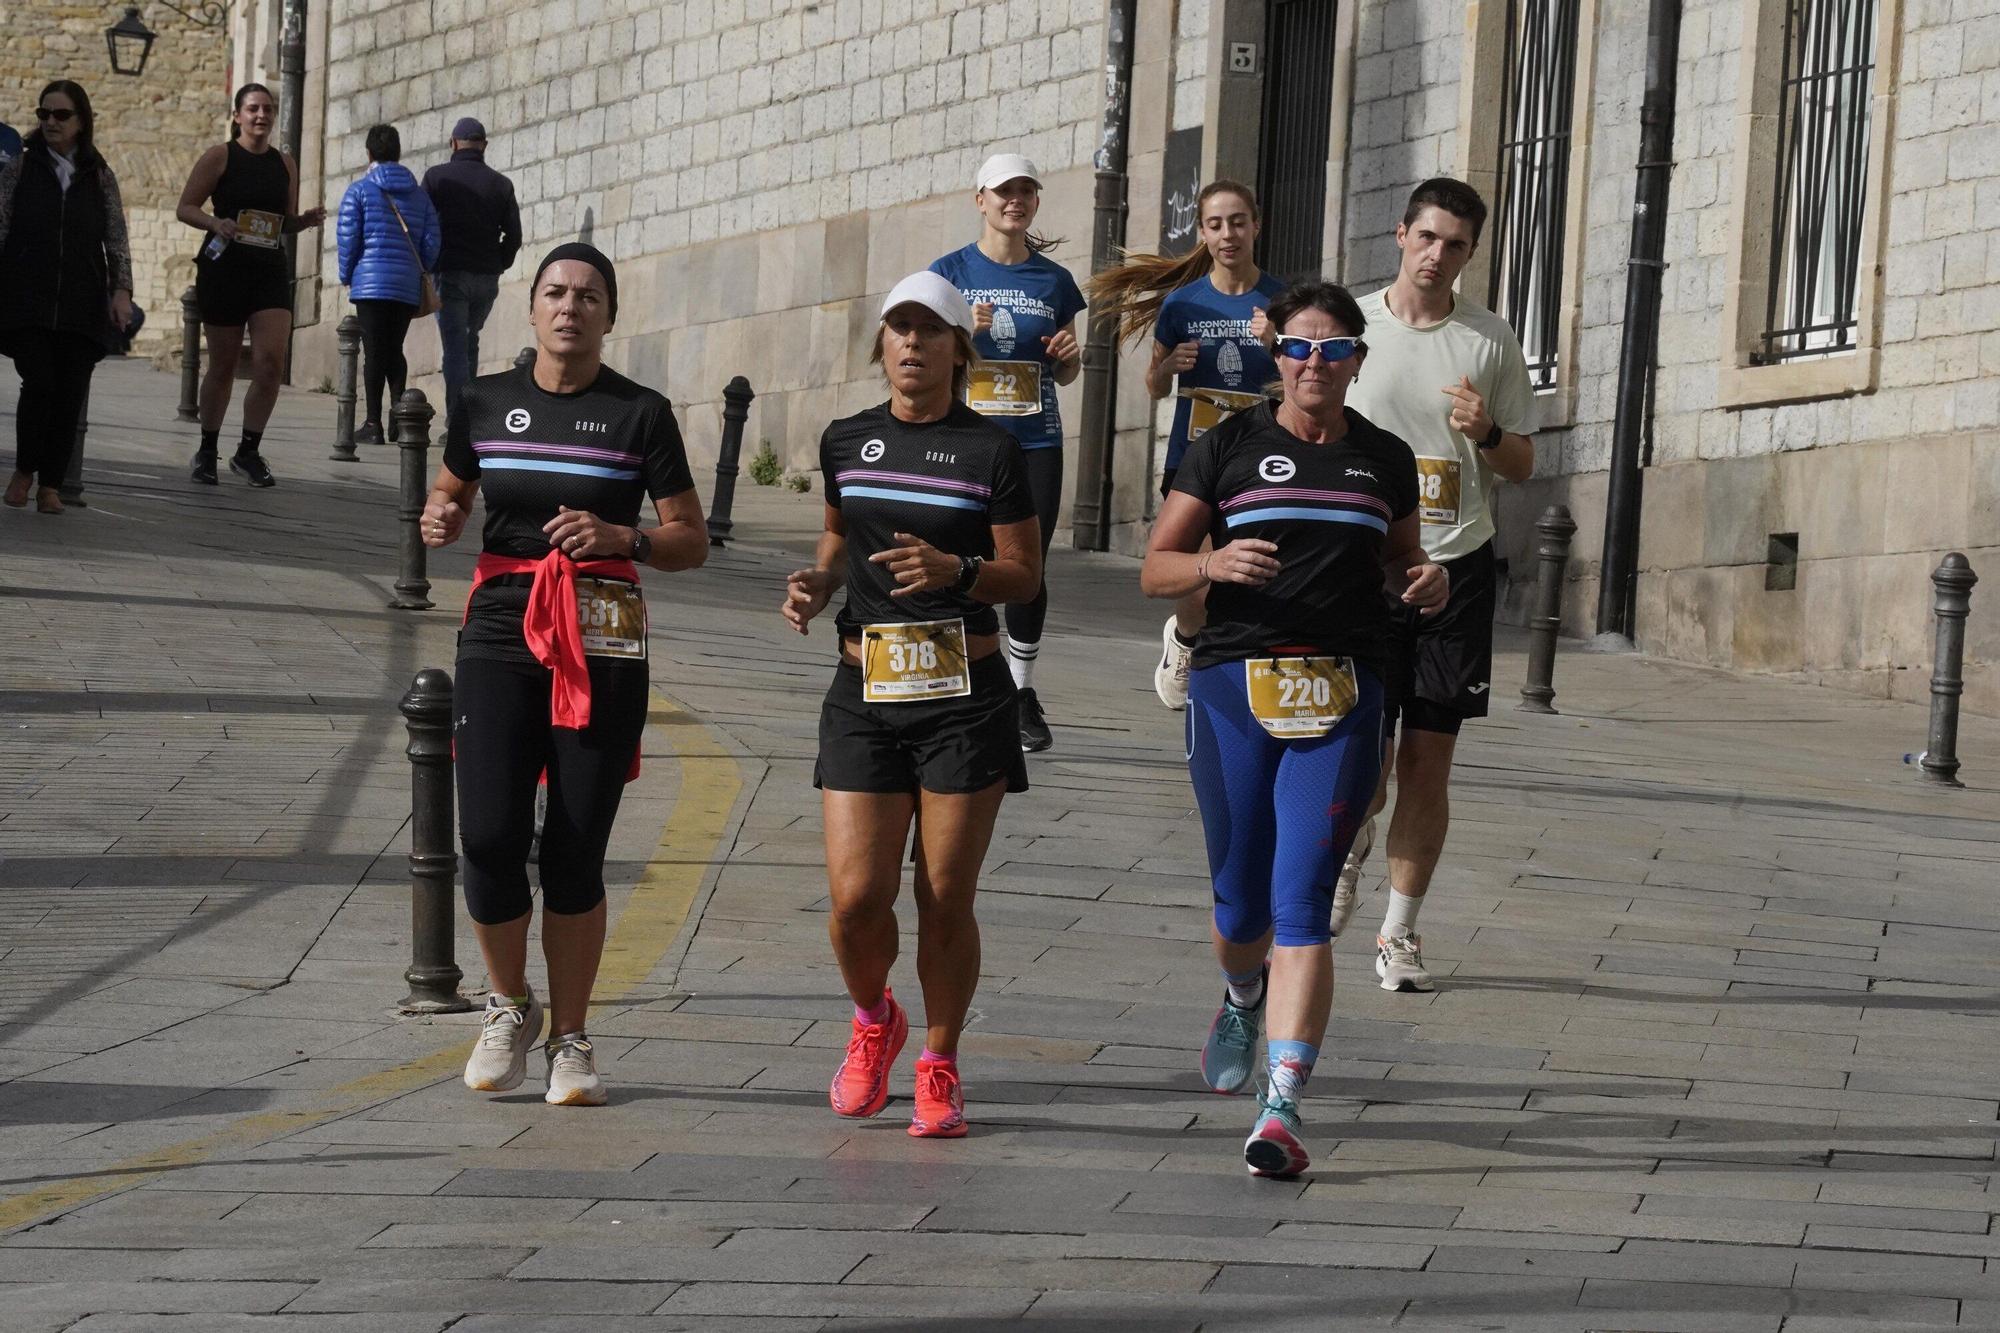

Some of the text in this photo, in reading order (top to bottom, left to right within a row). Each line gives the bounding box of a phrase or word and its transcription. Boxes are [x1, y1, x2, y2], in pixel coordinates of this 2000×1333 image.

[970, 288, 1026, 298] CONQUISTA
[1012, 306, 1055, 321] KONKISTA
[1187, 319, 1253, 329] LA CONQUISTA
[993, 374, 1017, 395] 22
[575, 421, 607, 433] GOBIK
[925, 451, 956, 464] GOBIK
[577, 597, 619, 628] 531
[889, 640, 937, 672] 378
[900, 673, 930, 681] VIRGINIA
[1278, 677, 1330, 708] 220
[1294, 707, 1316, 717] MARÍA
